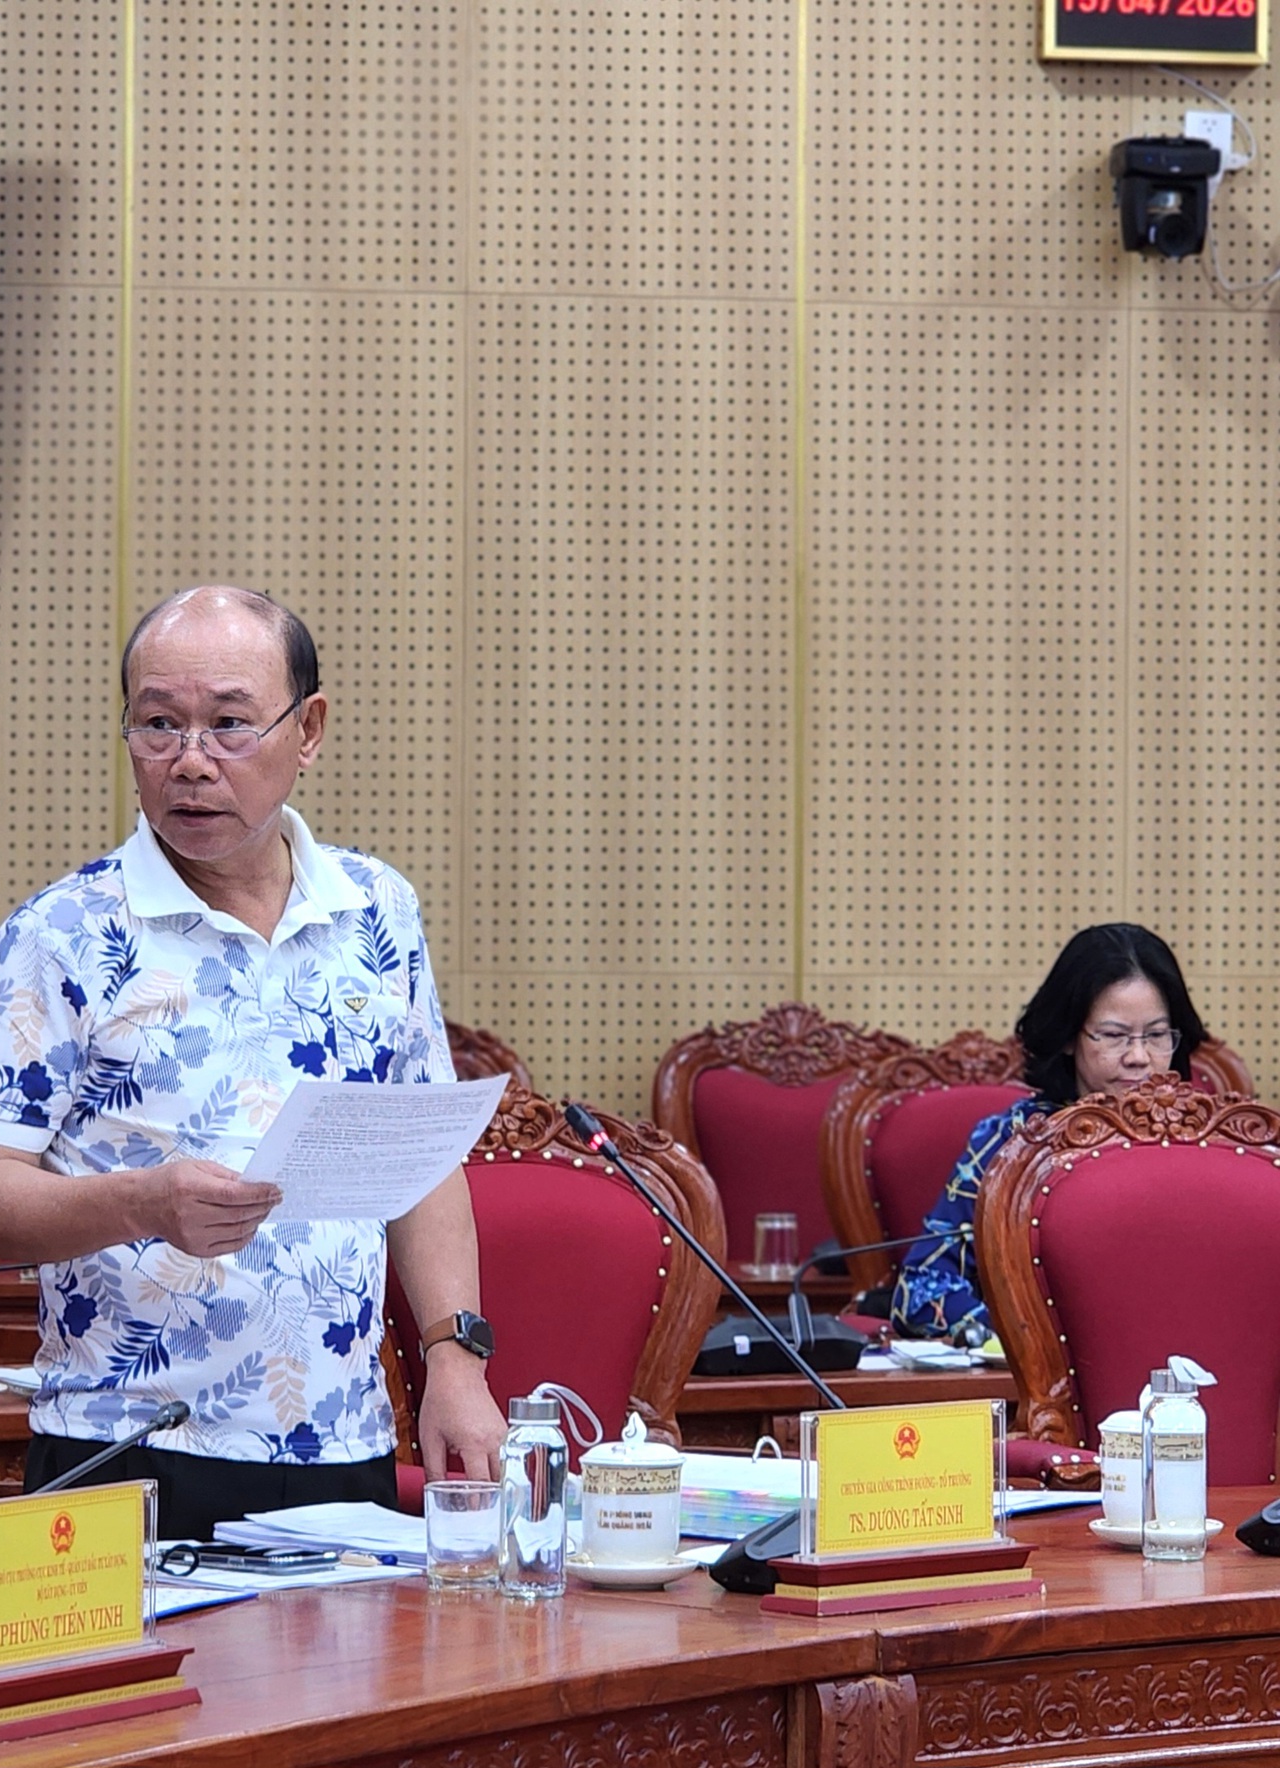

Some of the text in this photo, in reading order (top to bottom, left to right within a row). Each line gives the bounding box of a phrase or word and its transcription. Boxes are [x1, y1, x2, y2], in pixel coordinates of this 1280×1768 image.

[849, 1498, 964, 1533] TS. DƯƠNG TẤT SINH
[0, 1602, 124, 1647] PHÙNG TIẾN VINH
